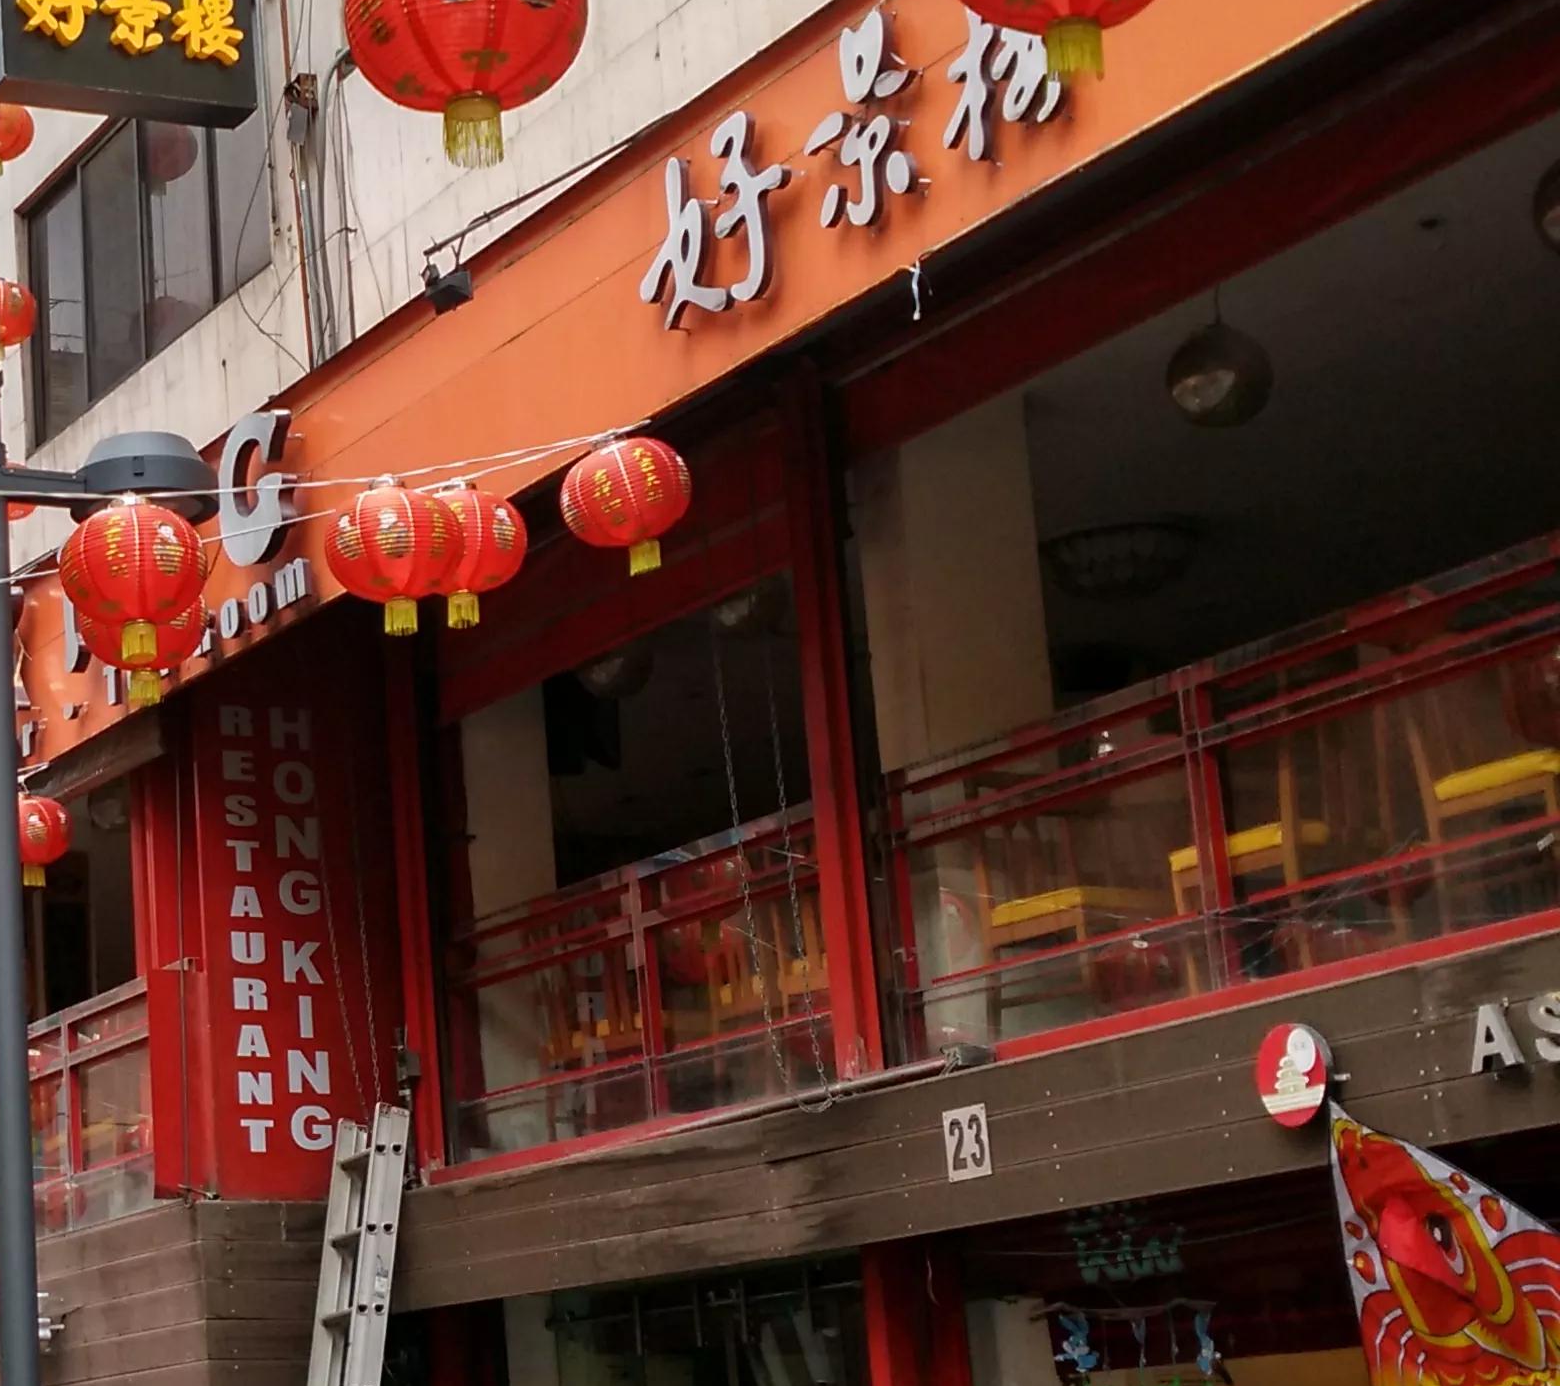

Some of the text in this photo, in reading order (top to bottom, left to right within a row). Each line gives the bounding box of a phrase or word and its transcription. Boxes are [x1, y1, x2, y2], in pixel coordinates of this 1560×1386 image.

[219, 705, 274, 1154] RESTAURANT
[268, 707, 333, 1151] HONG KING
[947, 1113, 987, 1171] 23
